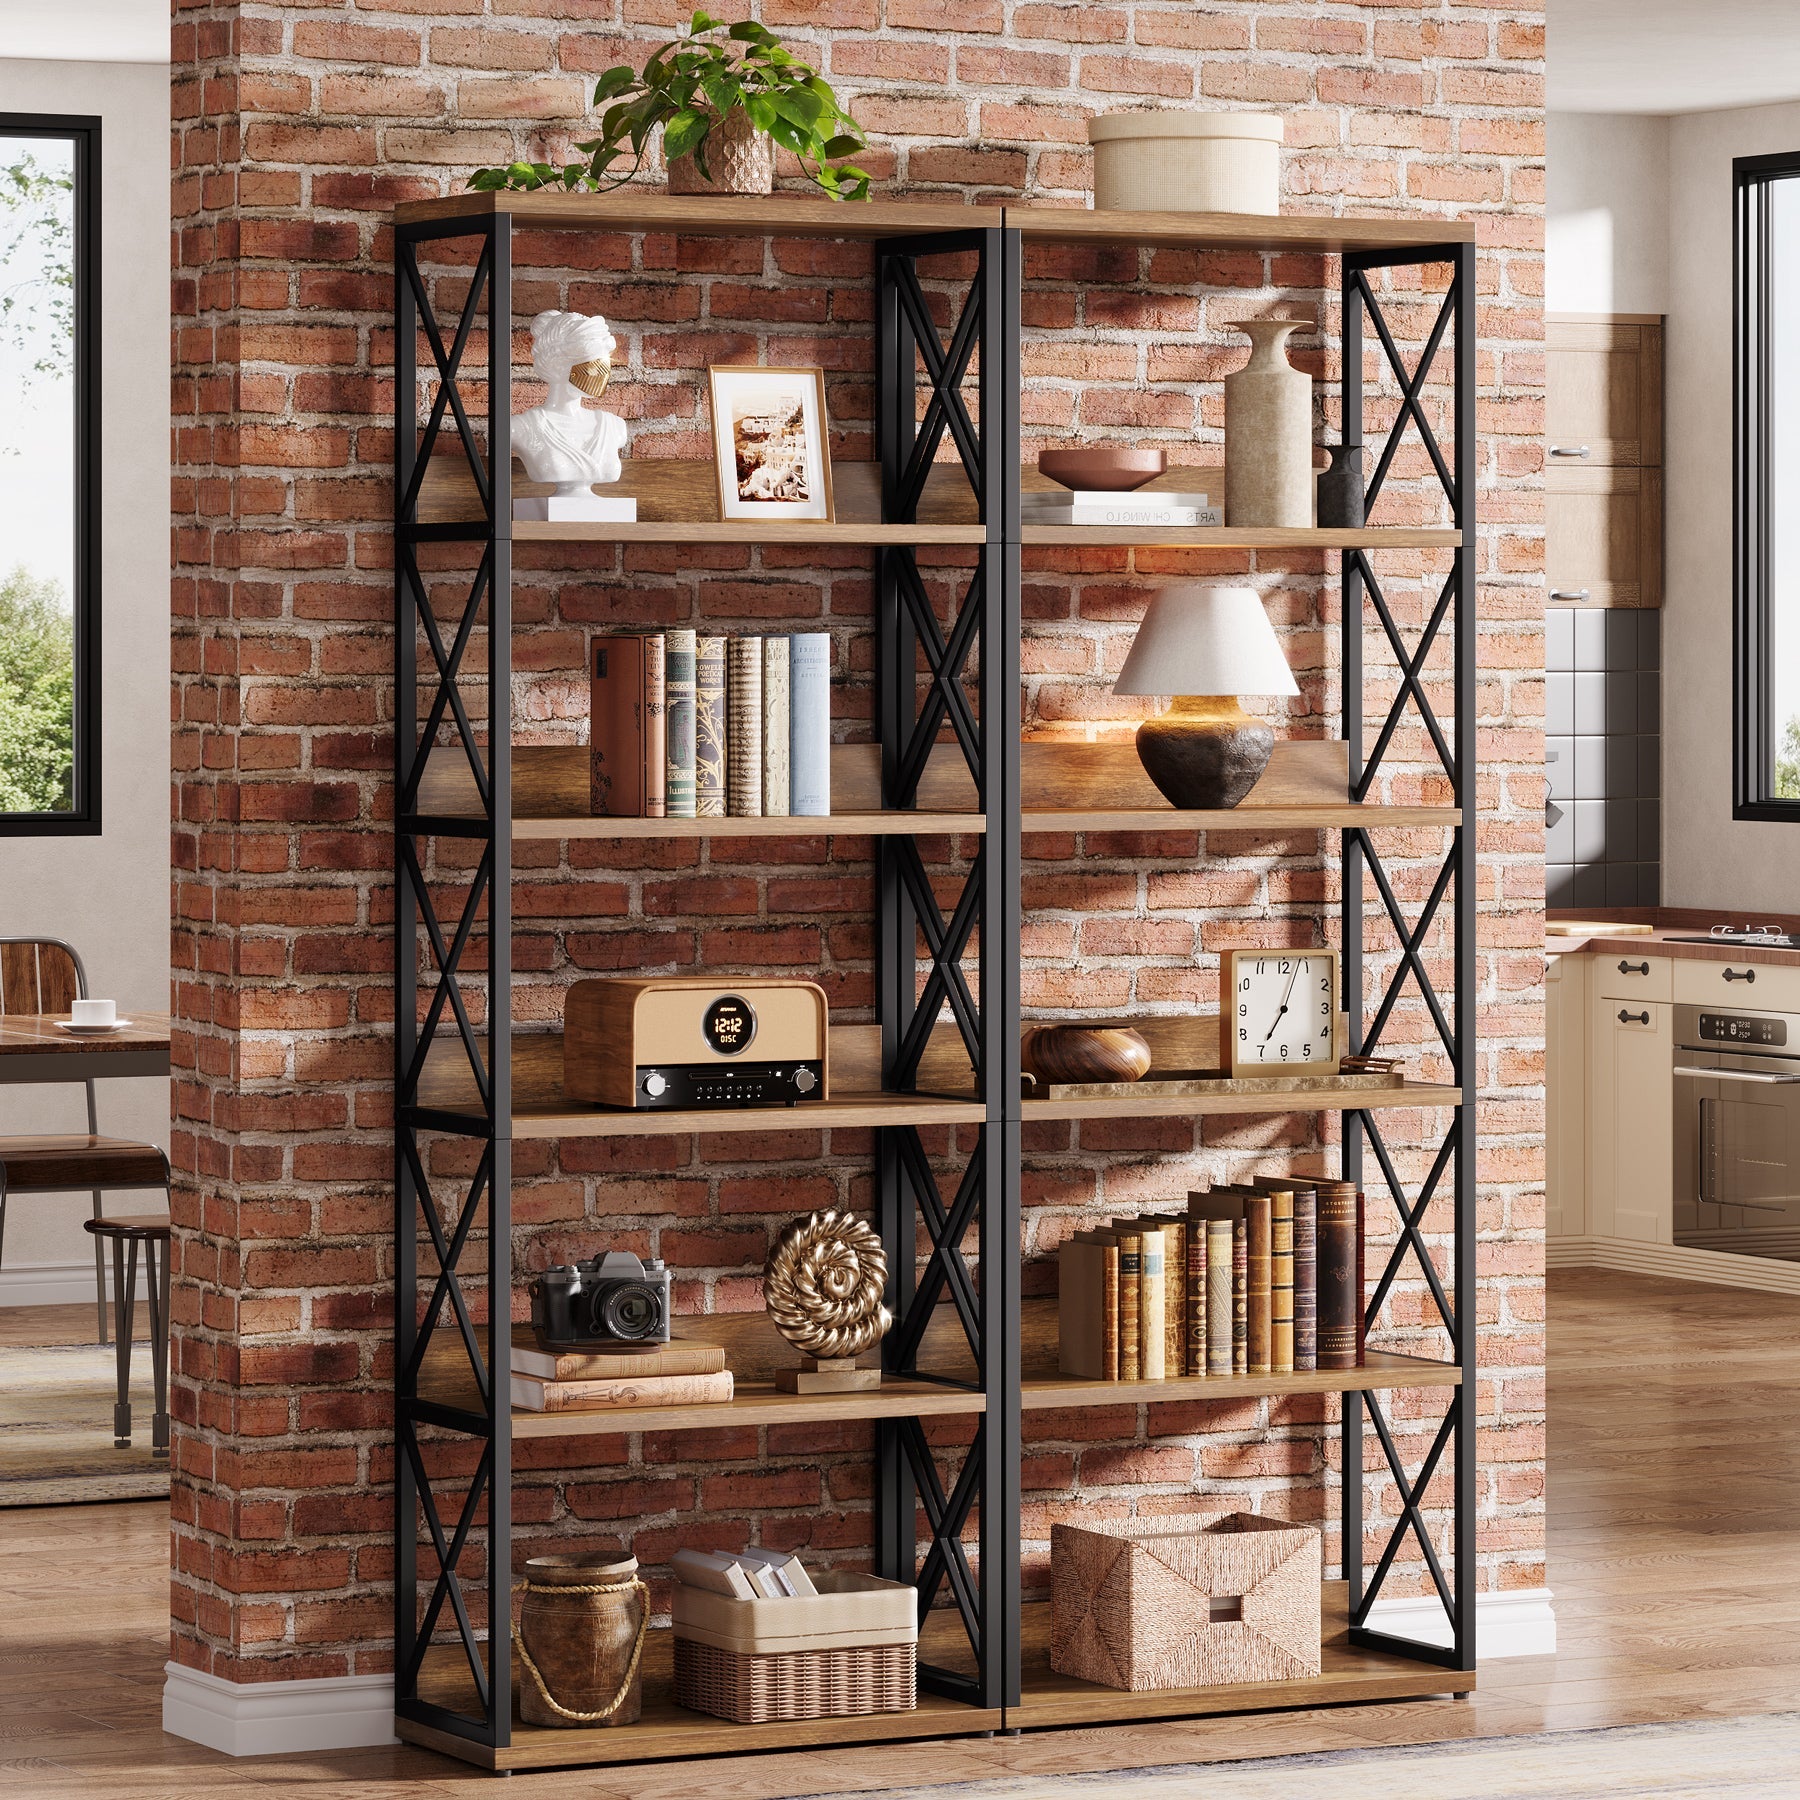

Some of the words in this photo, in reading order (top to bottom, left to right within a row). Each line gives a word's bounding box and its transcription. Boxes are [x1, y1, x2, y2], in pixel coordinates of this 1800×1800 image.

[1256, 961, 1265, 975] 11
[1277, 961, 1291, 975] 12
[1304, 960, 1309, 974] 1
[1238, 977, 1250, 993] 10
[1320, 977, 1330, 993] 2
[1239, 1004, 1247, 1017] 9
[1320, 1001, 1330, 1015] 3
[715, 1018, 743, 1033] 12:12
[1320, 1025, 1330, 1039] 4
[720, 1035, 737, 1044] DISC
[1239, 1028, 1248, 1041] 8
[1257, 1045, 1265, 1058] 7
[1280, 1044, 1288, 1058] 6
[1302, 1043, 1311, 1057] 5
